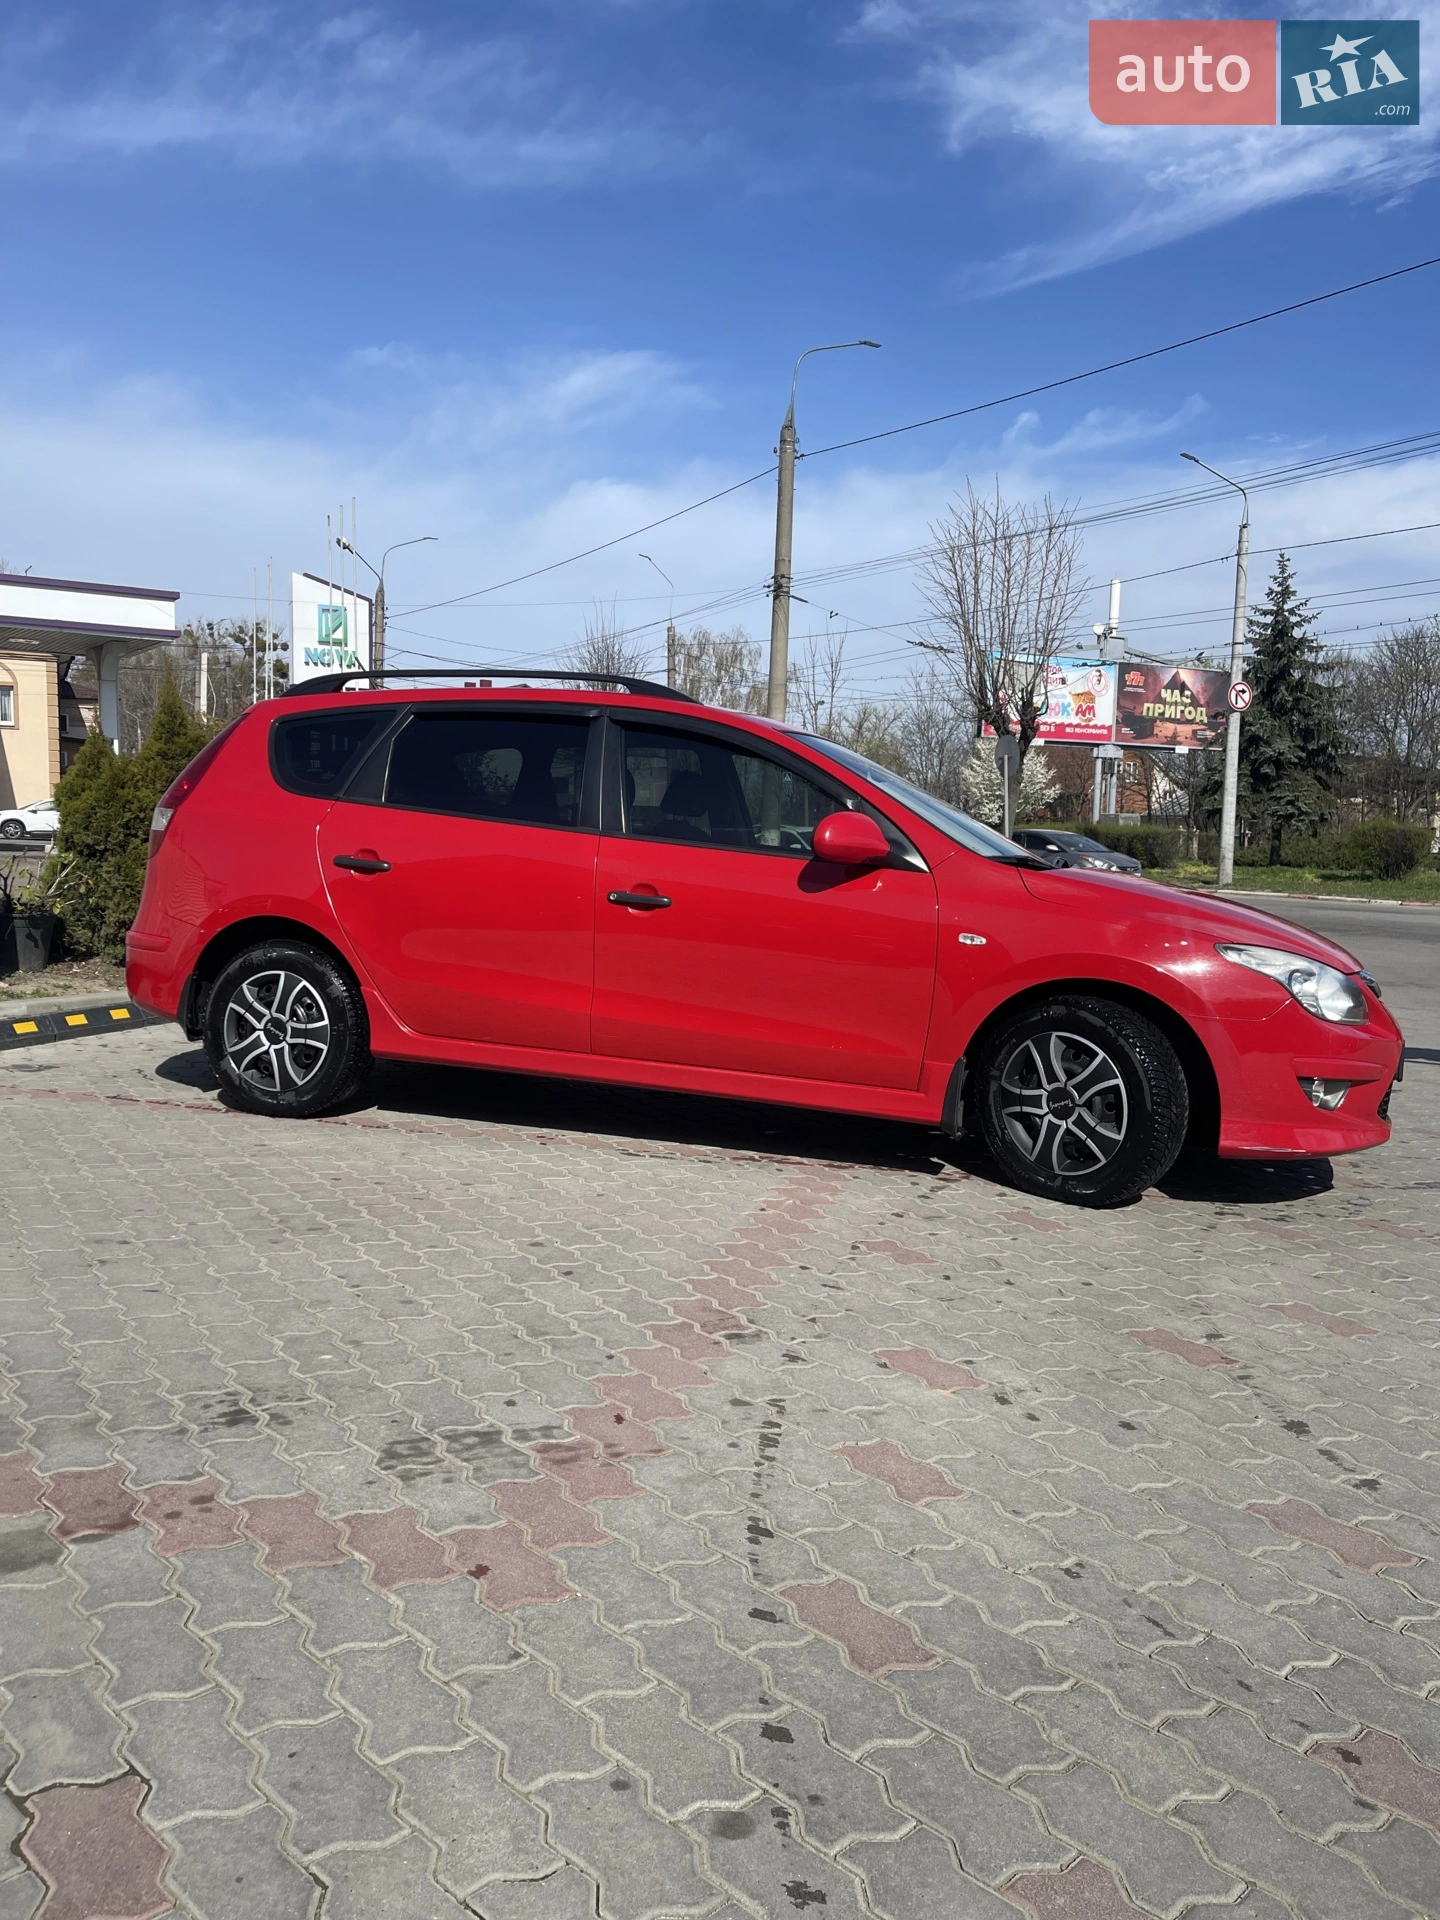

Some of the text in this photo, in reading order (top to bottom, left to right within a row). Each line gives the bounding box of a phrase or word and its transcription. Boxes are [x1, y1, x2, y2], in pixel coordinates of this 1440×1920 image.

[304, 647, 361, 670] NOVA
[1125, 671, 1145, 686] 777
[1160, 688, 1192, 704] ЧАС
[1142, 703, 1208, 724] ПРИГОД
